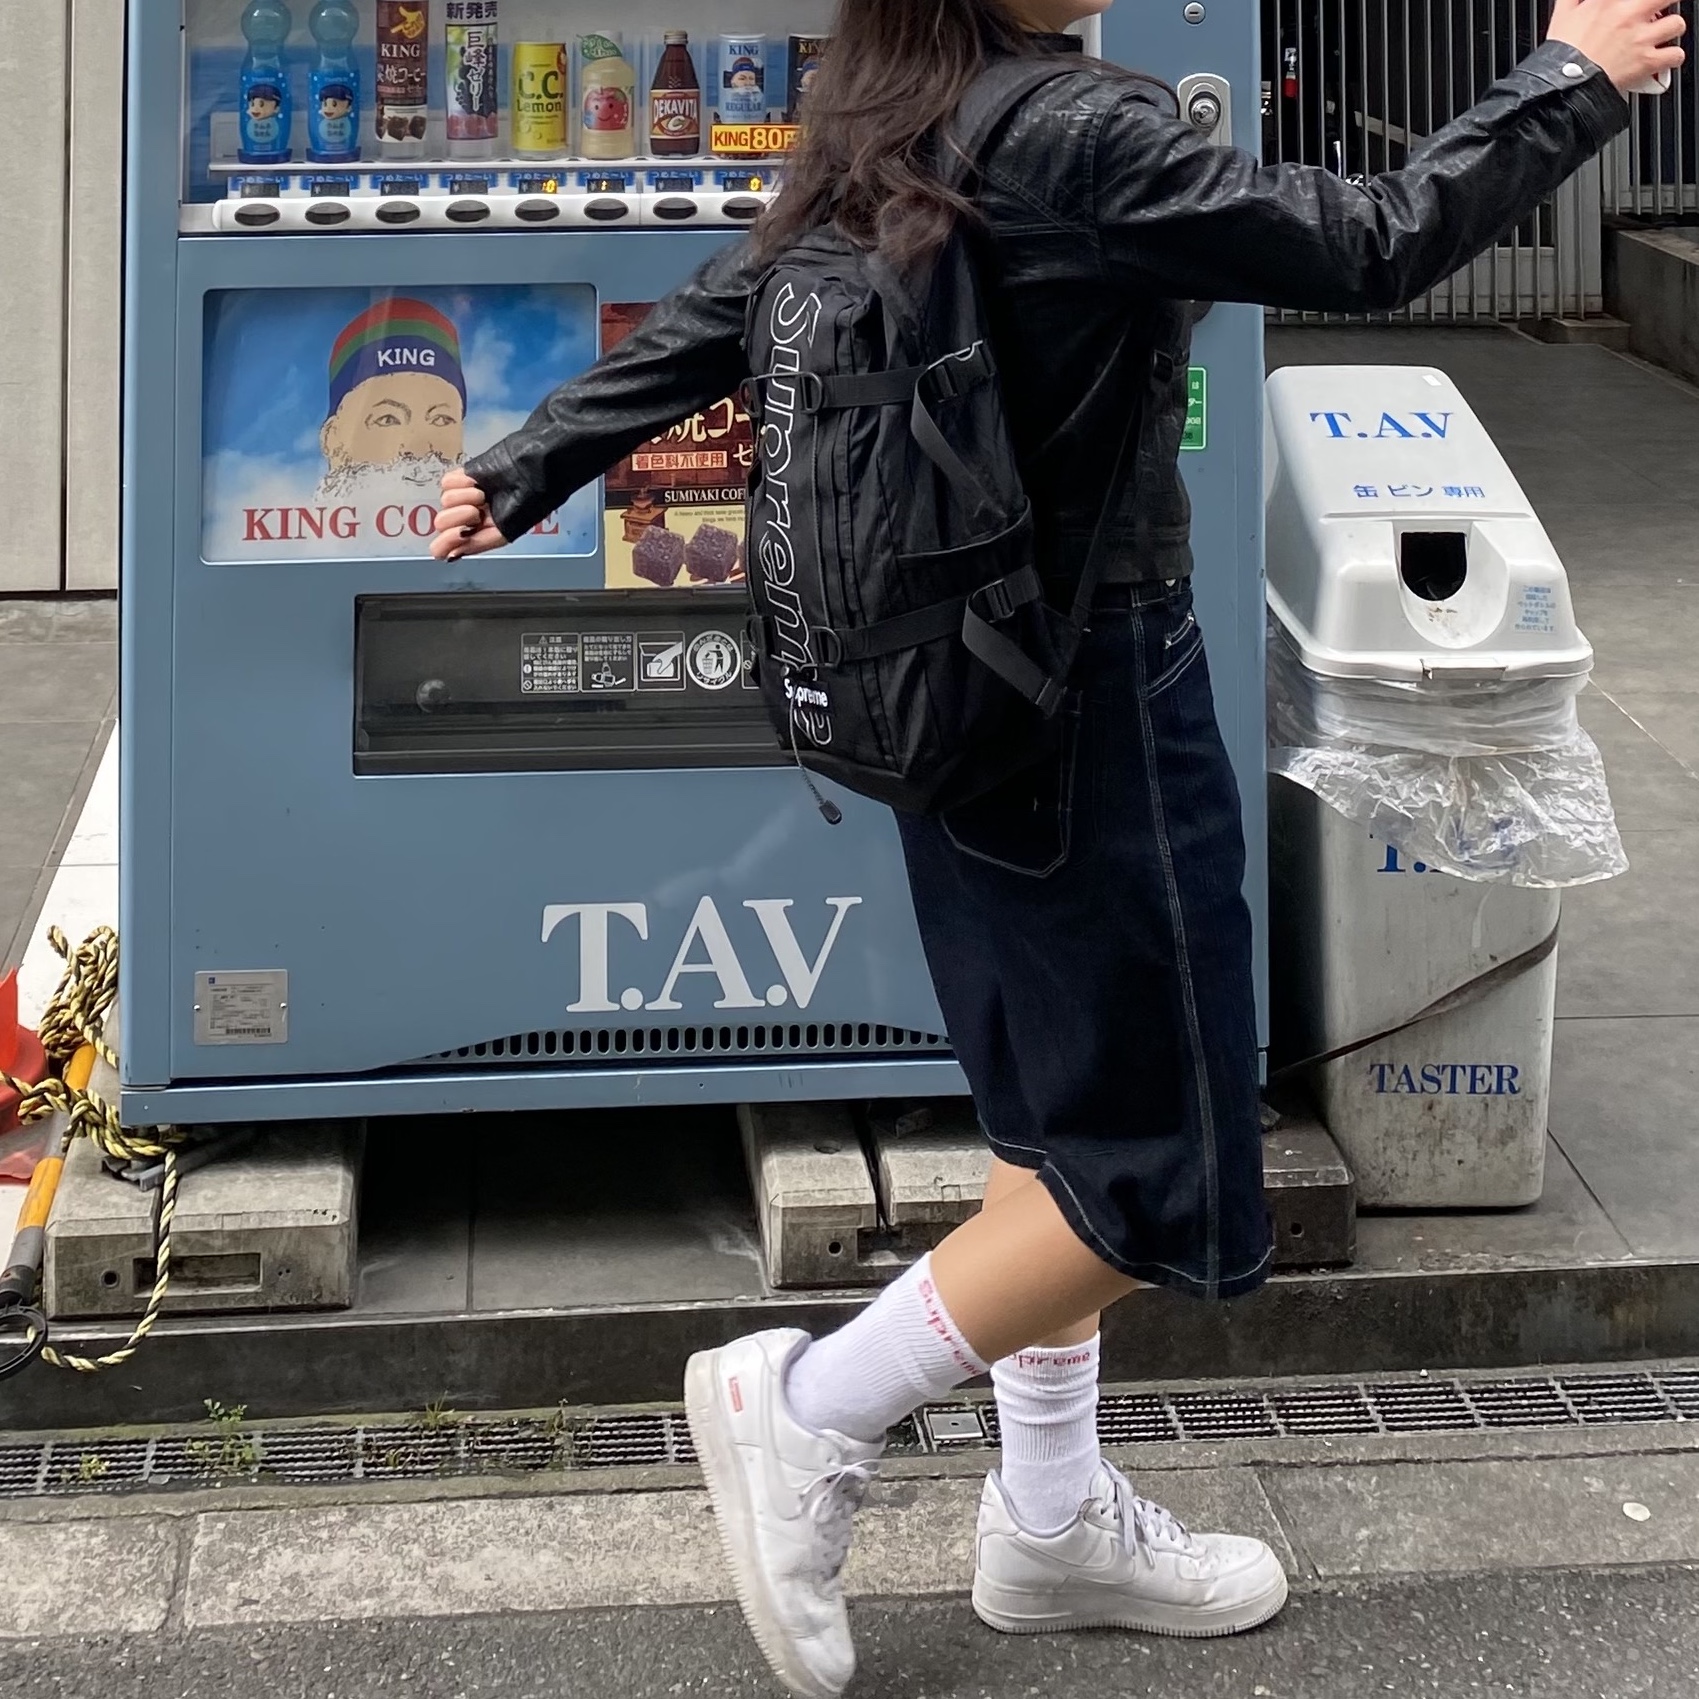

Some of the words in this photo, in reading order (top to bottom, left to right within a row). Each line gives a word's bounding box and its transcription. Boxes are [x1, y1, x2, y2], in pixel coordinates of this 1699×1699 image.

[446, 2, 497, 19] 新発売
[381, 43, 420, 57] KING
[729, 44, 758, 55] KING
[464, 29, 486, 111] 巨峰ゼリー
[518, 71, 563, 99] C.C.
[516, 99, 562, 112] Lemon
[653, 99, 697, 122] DEKAVITA
[714, 132, 748, 147] KING
[377, 348, 436, 367] KING
[1310, 411, 1454, 439] T.A.V
[665, 489, 719, 502] SUMIYAKI
[1353, 485, 1379, 498] 缶
[1388, 485, 1433, 497] ビン
[1443, 485, 1486, 498] 専用
[243, 507, 361, 540] KING
[375, 504, 560, 538] COE
[541, 895, 862, 1012] T.A.V
[1369, 1064, 1521, 1095] TASTER
